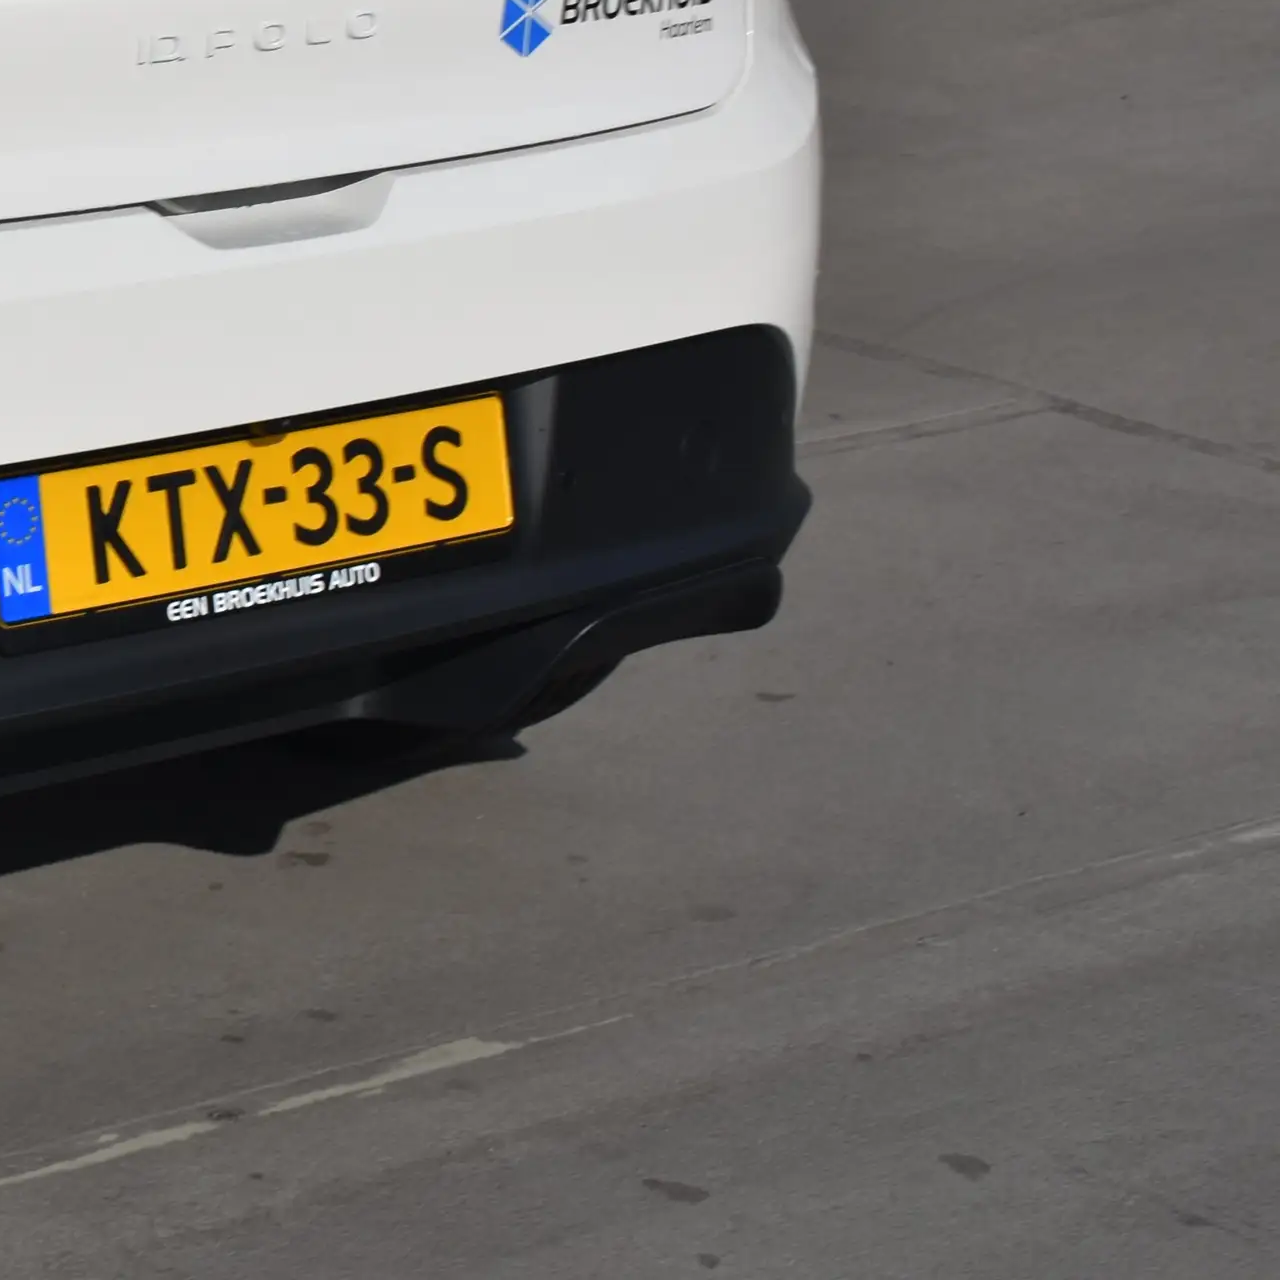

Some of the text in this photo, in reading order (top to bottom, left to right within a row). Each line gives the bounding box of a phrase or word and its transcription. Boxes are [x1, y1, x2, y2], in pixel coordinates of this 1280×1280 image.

[203, 11, 378, 60] POLO
[85, 426, 469, 585] KTX-33-S
[2, 563, 43, 597] NL
[166, 562, 382, 622] EEN BROEKHUIS AUTO
